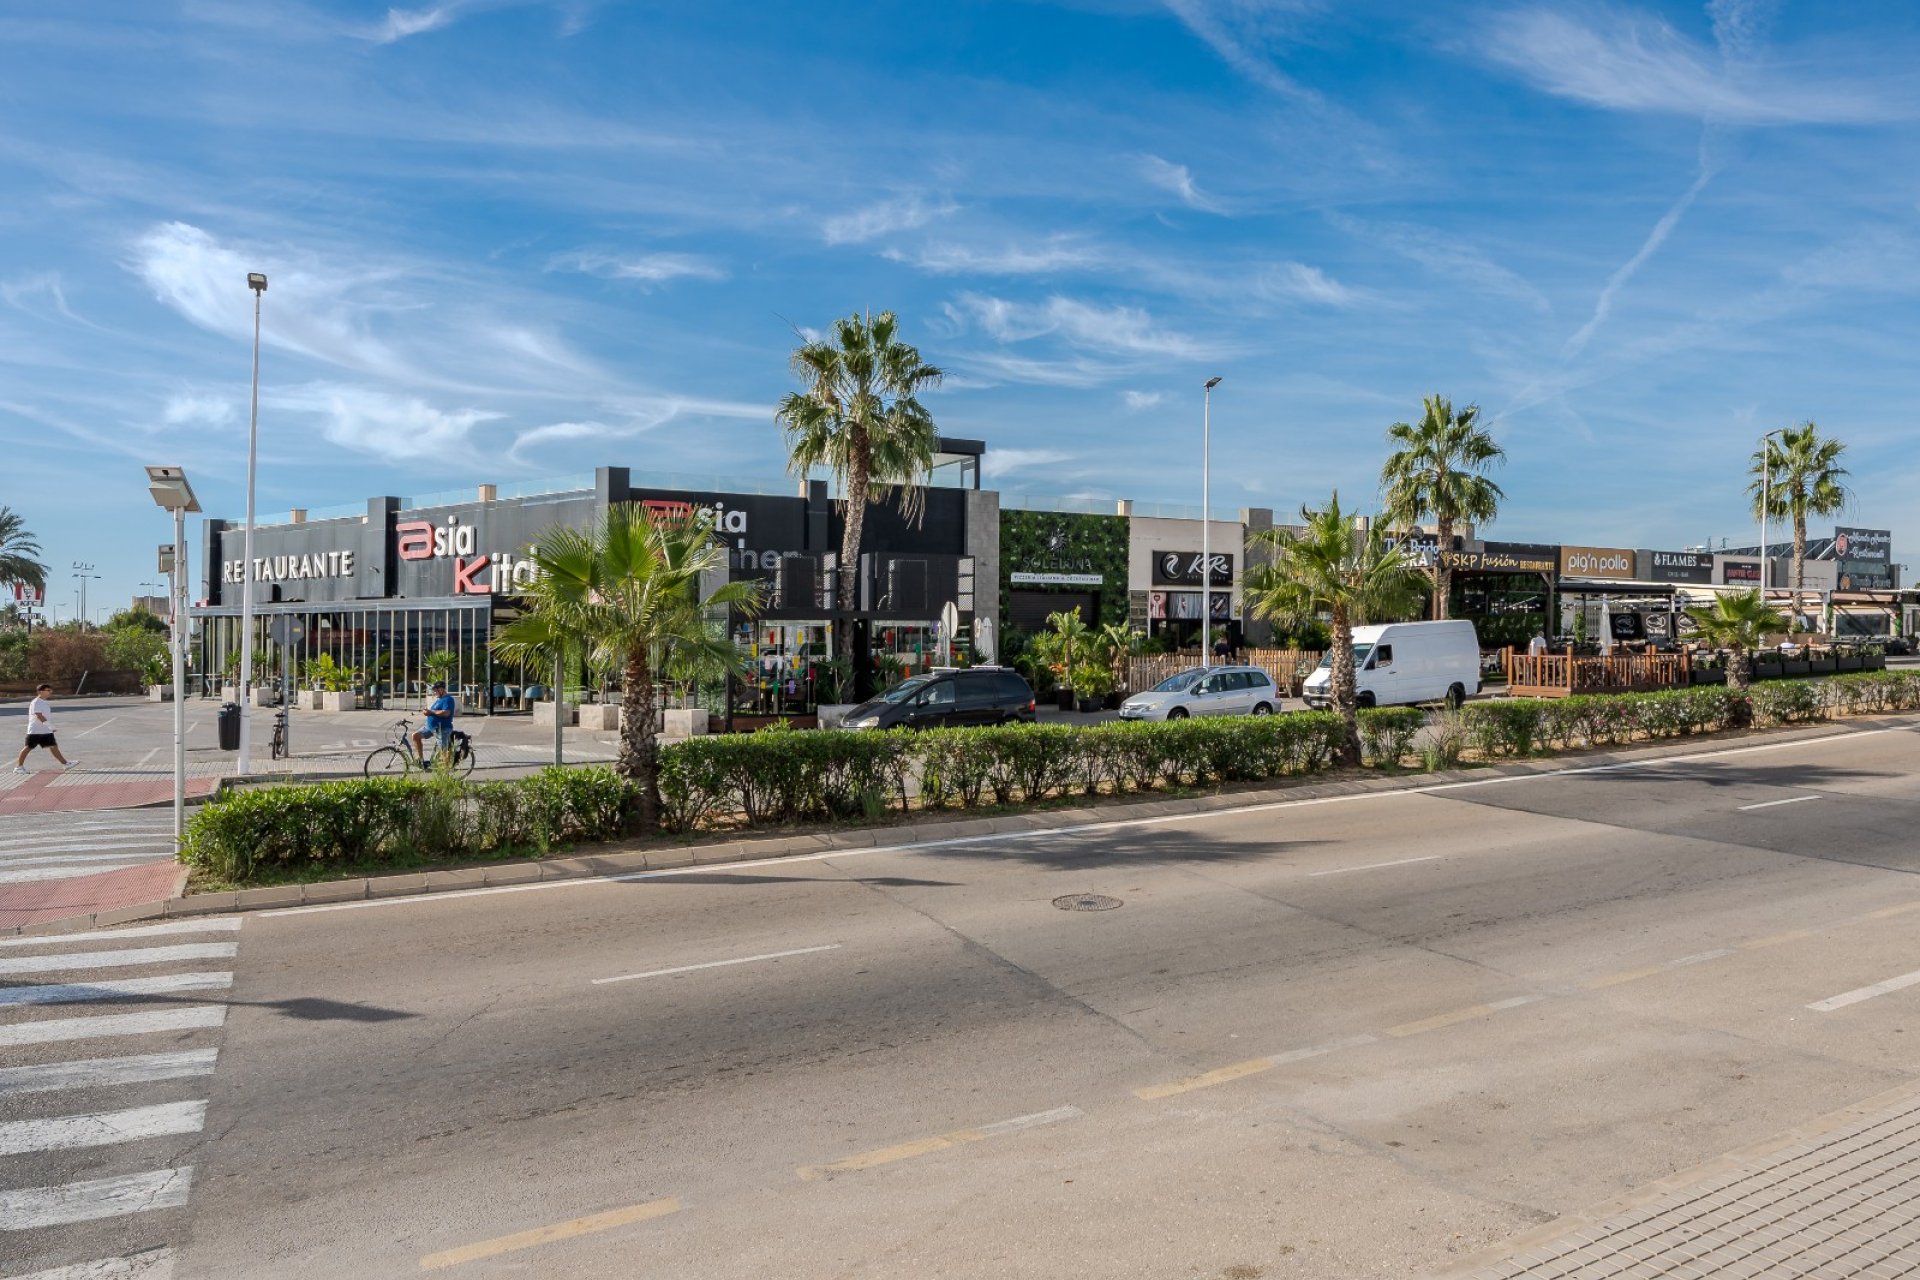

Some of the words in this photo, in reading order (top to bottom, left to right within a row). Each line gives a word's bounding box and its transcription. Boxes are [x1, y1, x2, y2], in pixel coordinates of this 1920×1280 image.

[1410, 539, 1440, 560] Bridg
[223, 550, 354, 583] RETAURANTE
[1453, 553, 1477, 568] SKP
[1480, 552, 1519, 569] fusión
[1568, 553, 1598, 572] pig'n
[1600, 554, 1628, 572] pollo
[1662, 554, 1697, 567] FLAMES
